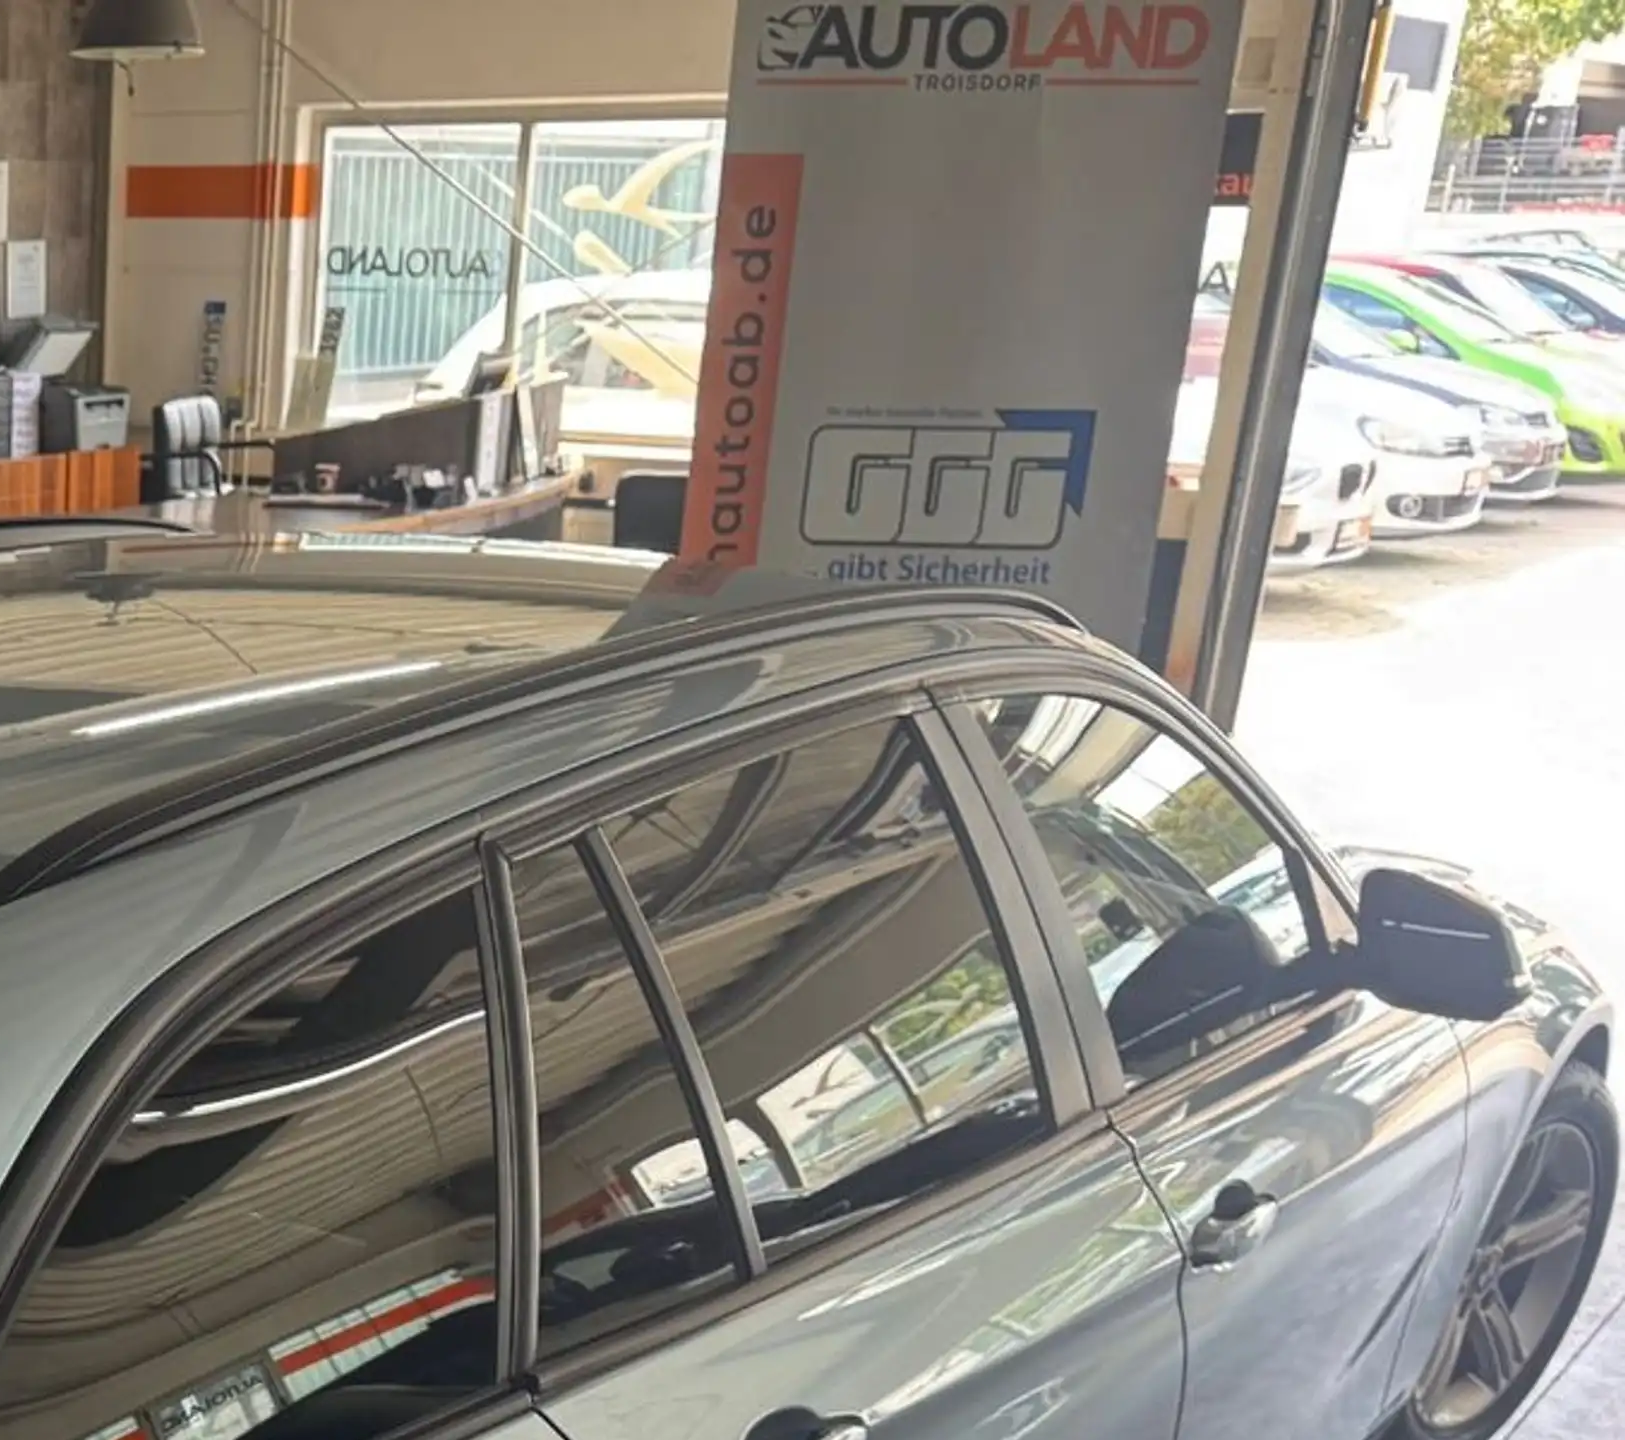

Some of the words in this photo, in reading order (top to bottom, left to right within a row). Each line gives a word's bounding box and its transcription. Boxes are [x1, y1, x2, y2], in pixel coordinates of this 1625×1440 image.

[798, 3, 1211, 71] AUTOLAND
[913, 73, 1042, 93] TROISDORF
[827, 553, 888, 582] gibt
[897, 555, 1051, 584] Sicherheit
